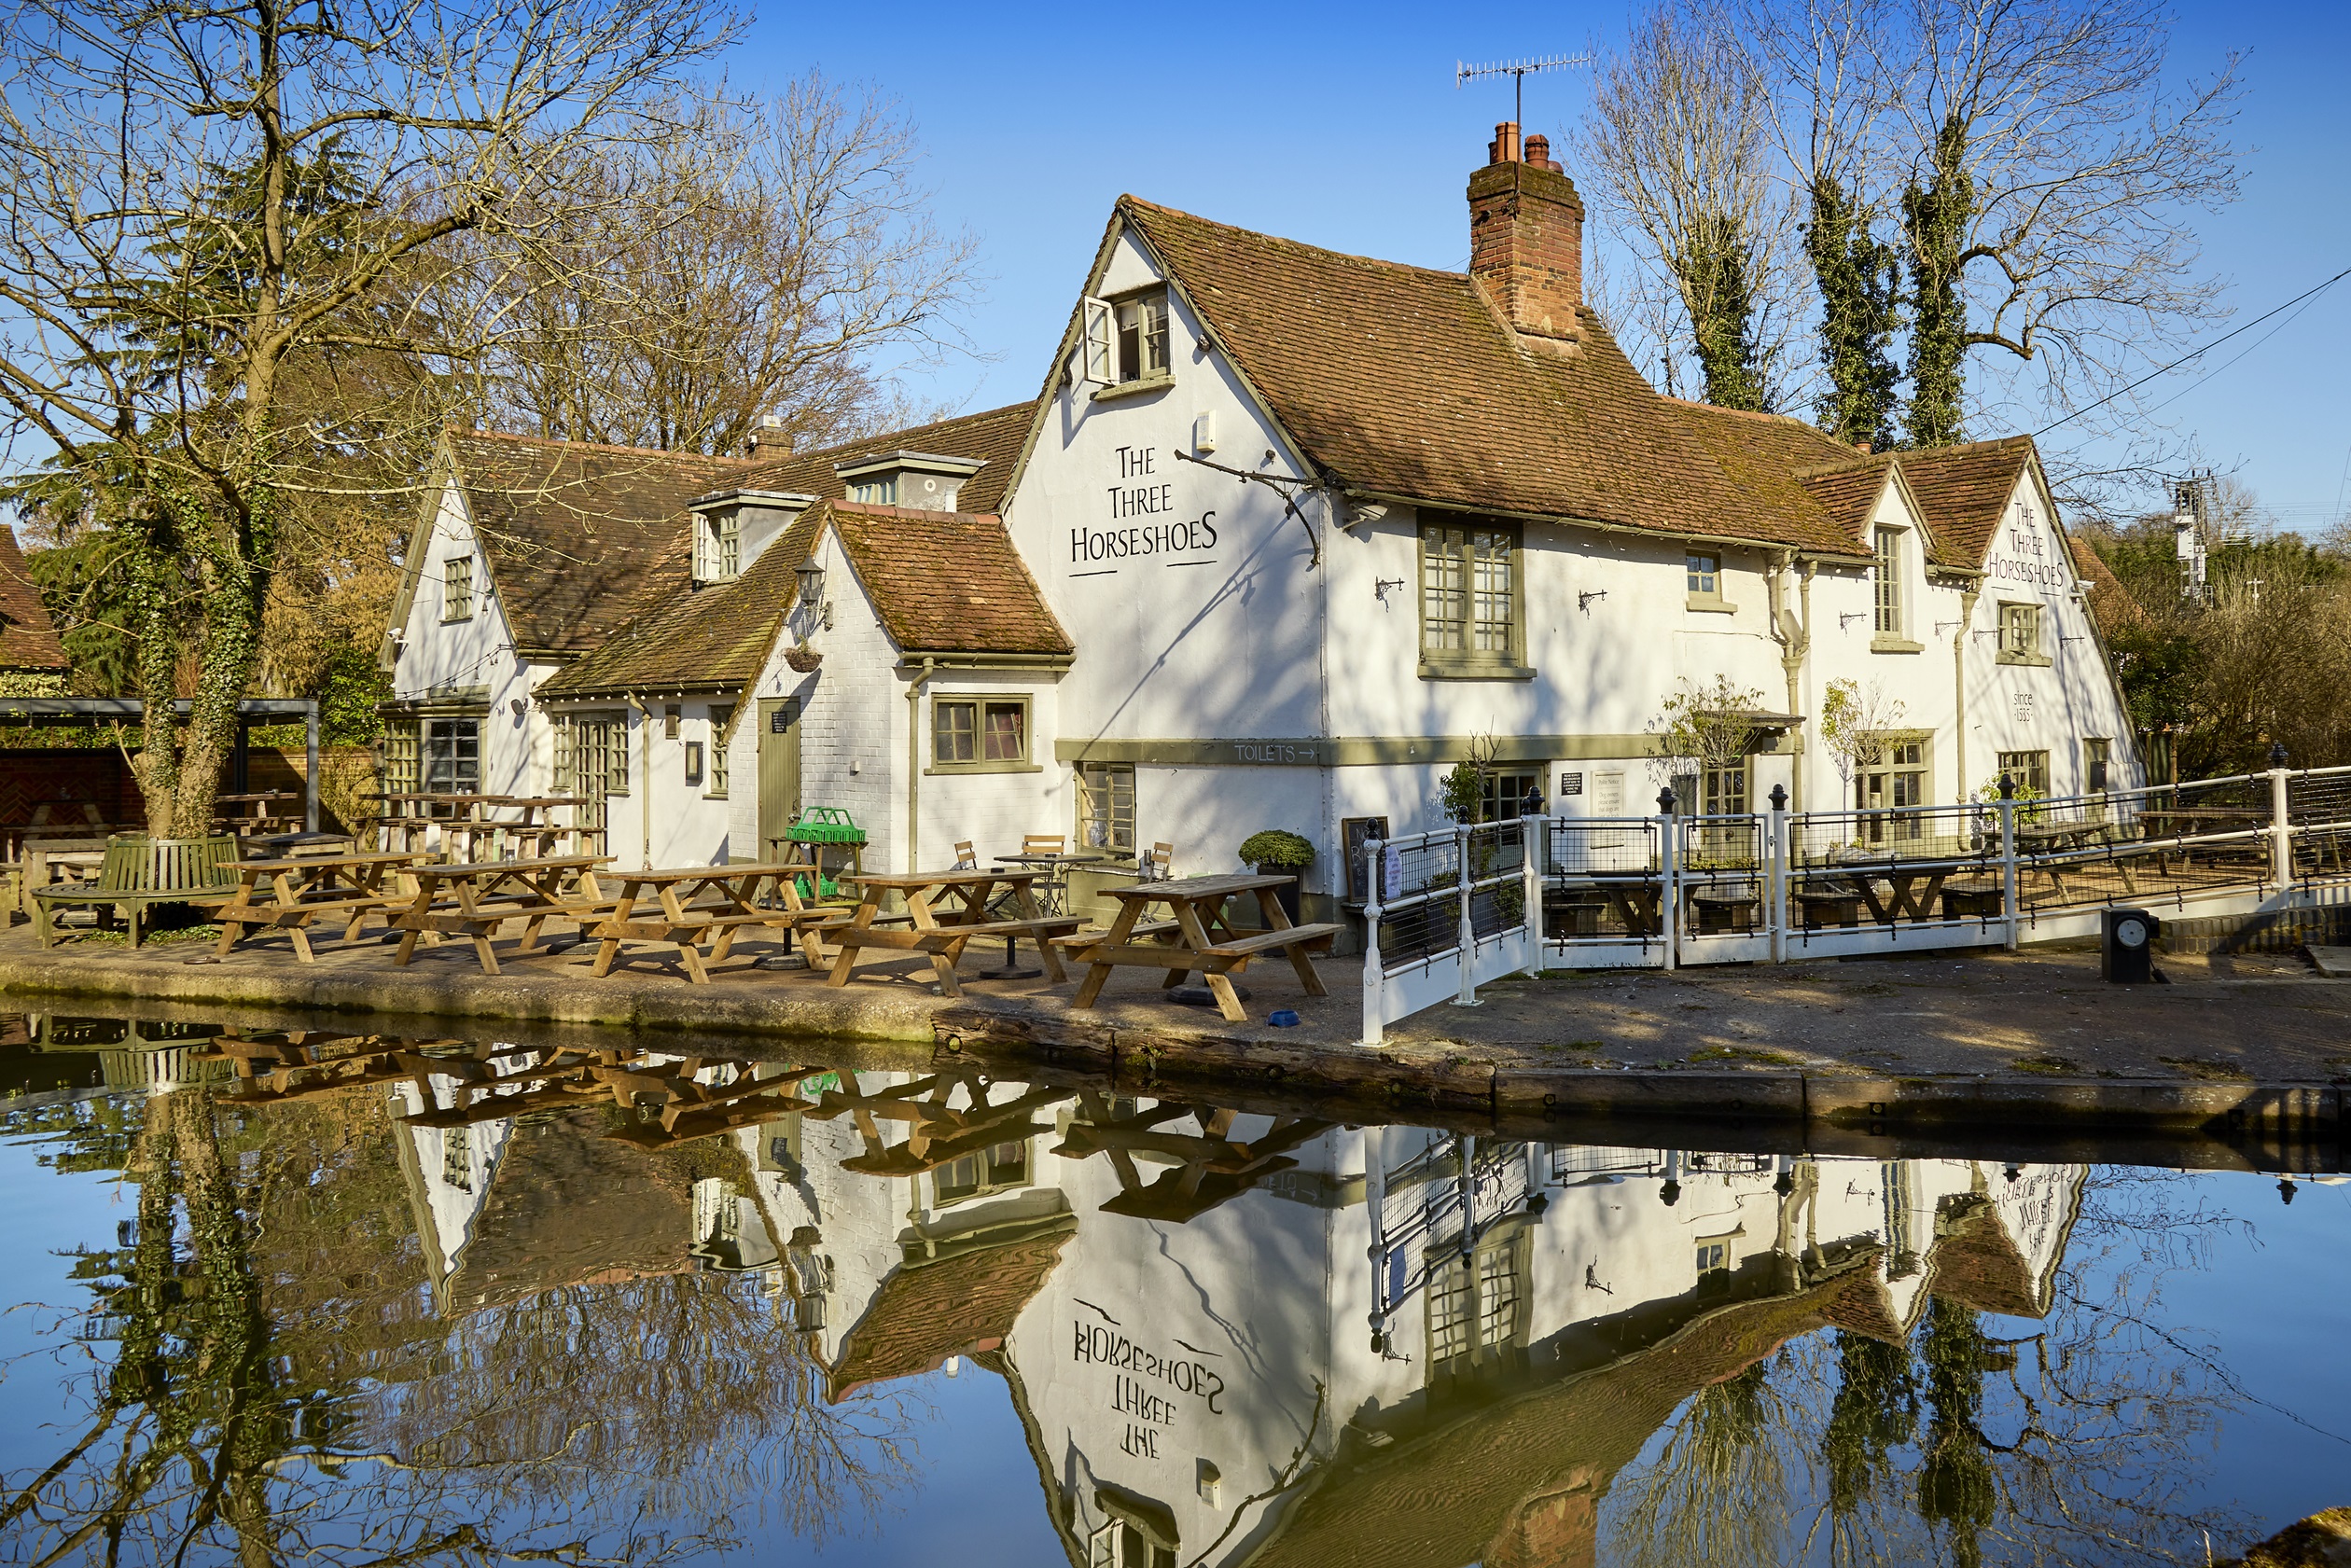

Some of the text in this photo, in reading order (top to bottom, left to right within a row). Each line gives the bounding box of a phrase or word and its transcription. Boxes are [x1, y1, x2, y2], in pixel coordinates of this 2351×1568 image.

[1115, 445, 1156, 479] THE
[1107, 483, 1174, 519] THREE
[2014, 502, 2036, 528] THE
[1071, 510, 1217, 562] HORSESHOES
[2010, 528, 2044, 557] THREE
[1989, 551, 2064, 588] HORSESHOES
[2013, 689, 2033, 706] since
[1233, 744, 1296, 763] TOILETS
